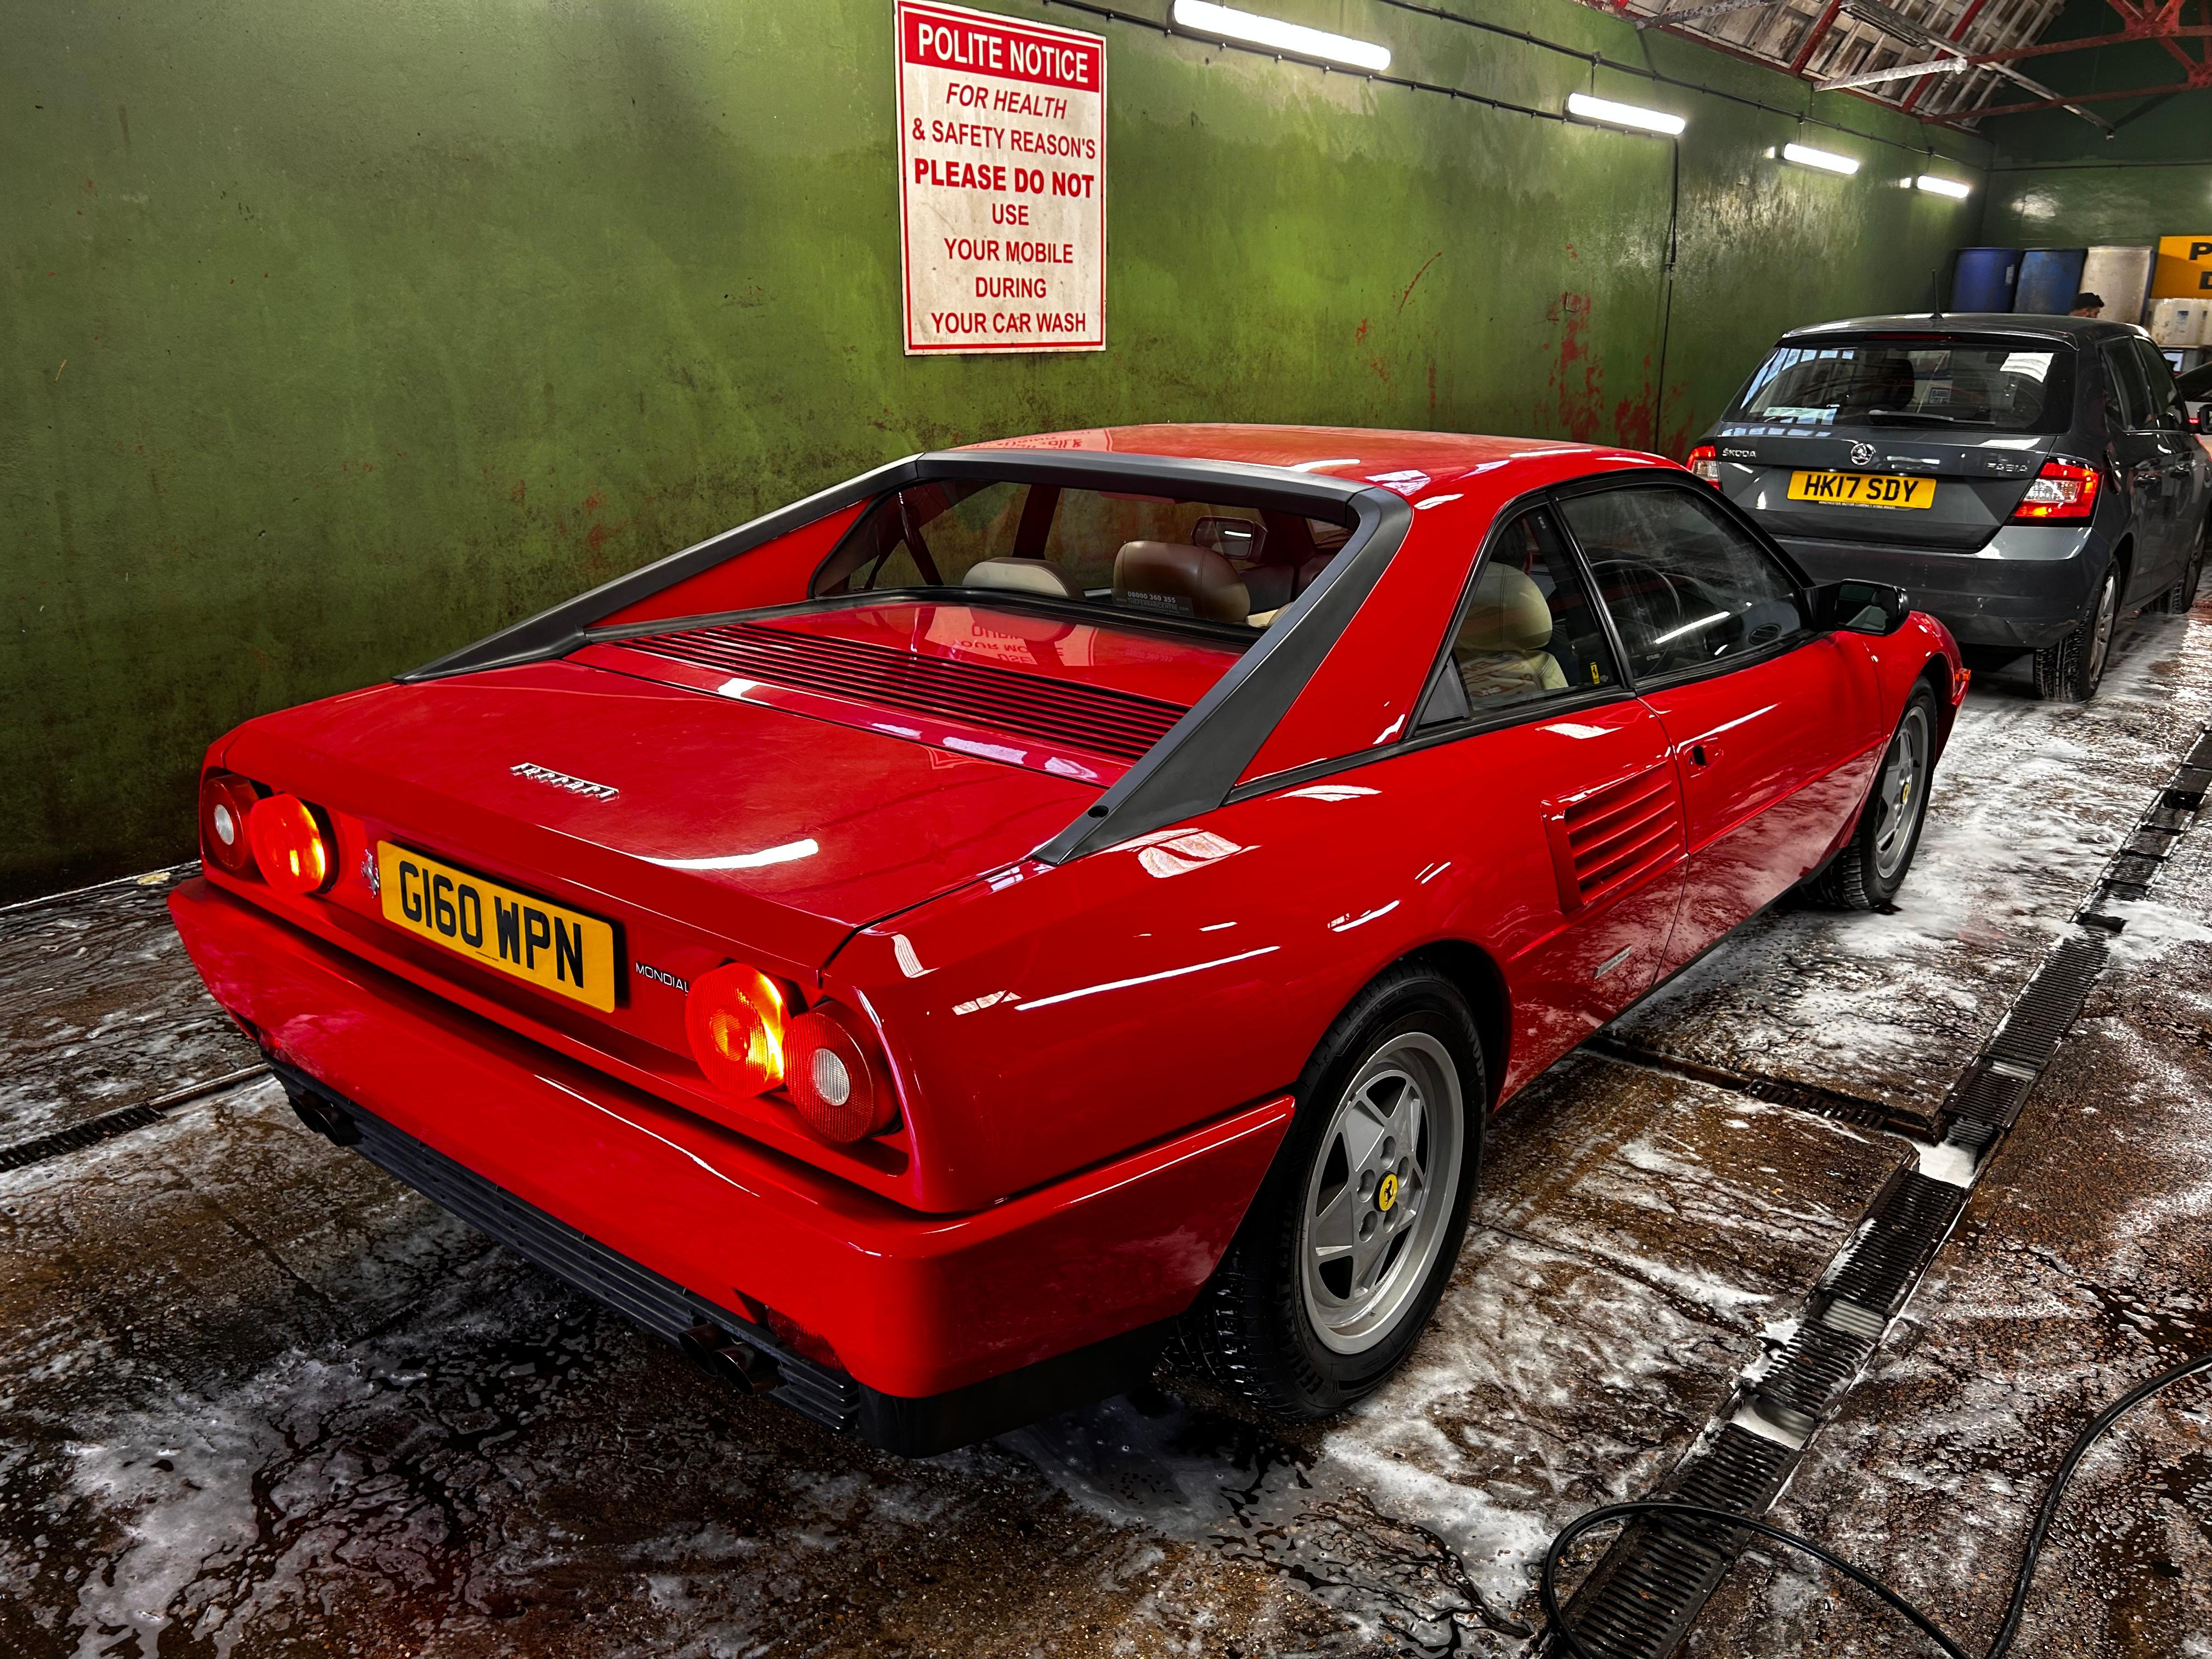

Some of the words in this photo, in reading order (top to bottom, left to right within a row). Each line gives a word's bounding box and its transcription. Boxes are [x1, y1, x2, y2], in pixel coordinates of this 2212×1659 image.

[918, 22, 1003, 69] POLITE
[1010, 40, 1089, 83] NOTICE
[946, 82, 988, 109] FOR
[994, 89, 1068, 120] HEALTH
[912, 117, 926, 141] &
[932, 120, 1005, 149] SAFETY
[1011, 129, 1096, 159] REASON'S
[915, 157, 1006, 190] PLEASE
[1014, 168, 1045, 194] DO
[1052, 172, 1094, 198] NOT
[992, 203, 1029, 225] USE
[944, 238, 1000, 261] YOUR
[1006, 241, 1074, 263] MOBILE
[975, 276, 1046, 298] DURING
[932, 313, 988, 334] YOUR
[992, 313, 1031, 333] CAR
[1036, 313, 1086, 332] WASH
[1803, 474, 1861, 498] HK17
[1866, 478, 1919, 502] SDY
[1127, 591, 1148, 599] 08000
[399, 860, 483, 949] G160
[494, 895, 584, 989] WPN
[635, 962, 689, 993] MONDIAL
